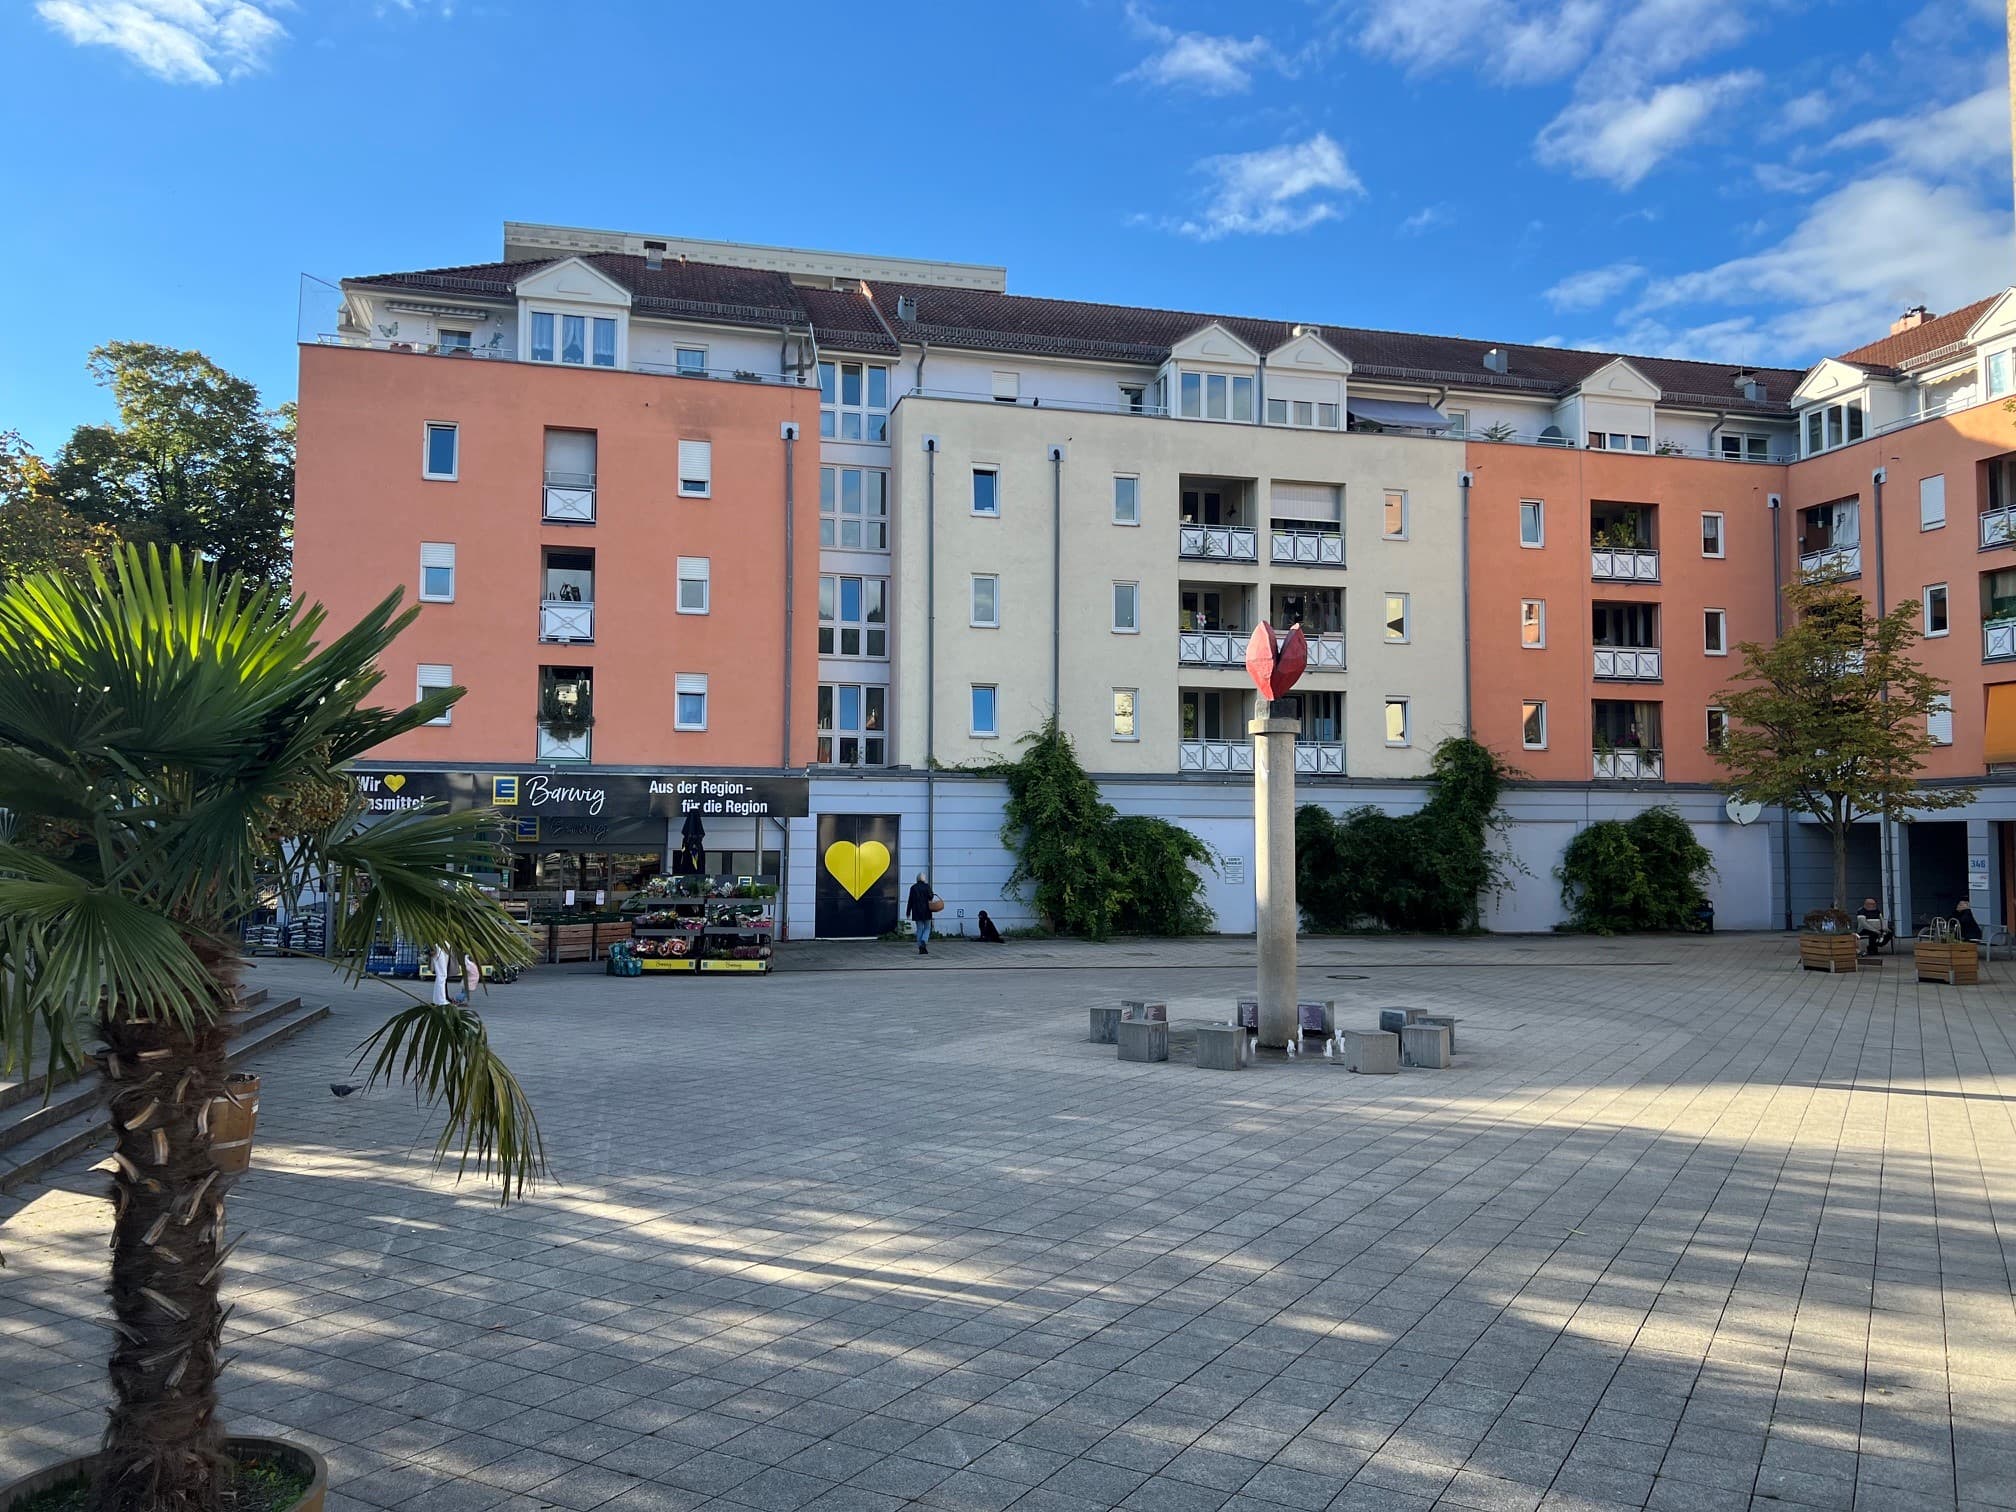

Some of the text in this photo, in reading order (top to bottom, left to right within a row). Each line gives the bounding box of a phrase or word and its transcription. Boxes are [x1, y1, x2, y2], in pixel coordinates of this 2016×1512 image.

[356, 776, 381, 792] Wir
[649, 780, 674, 794] Aus
[677, 780, 698, 794] der
[701, 780, 744, 797] Region
[525, 775, 606, 816] Barwig
[681, 799, 768, 815] für die Region
